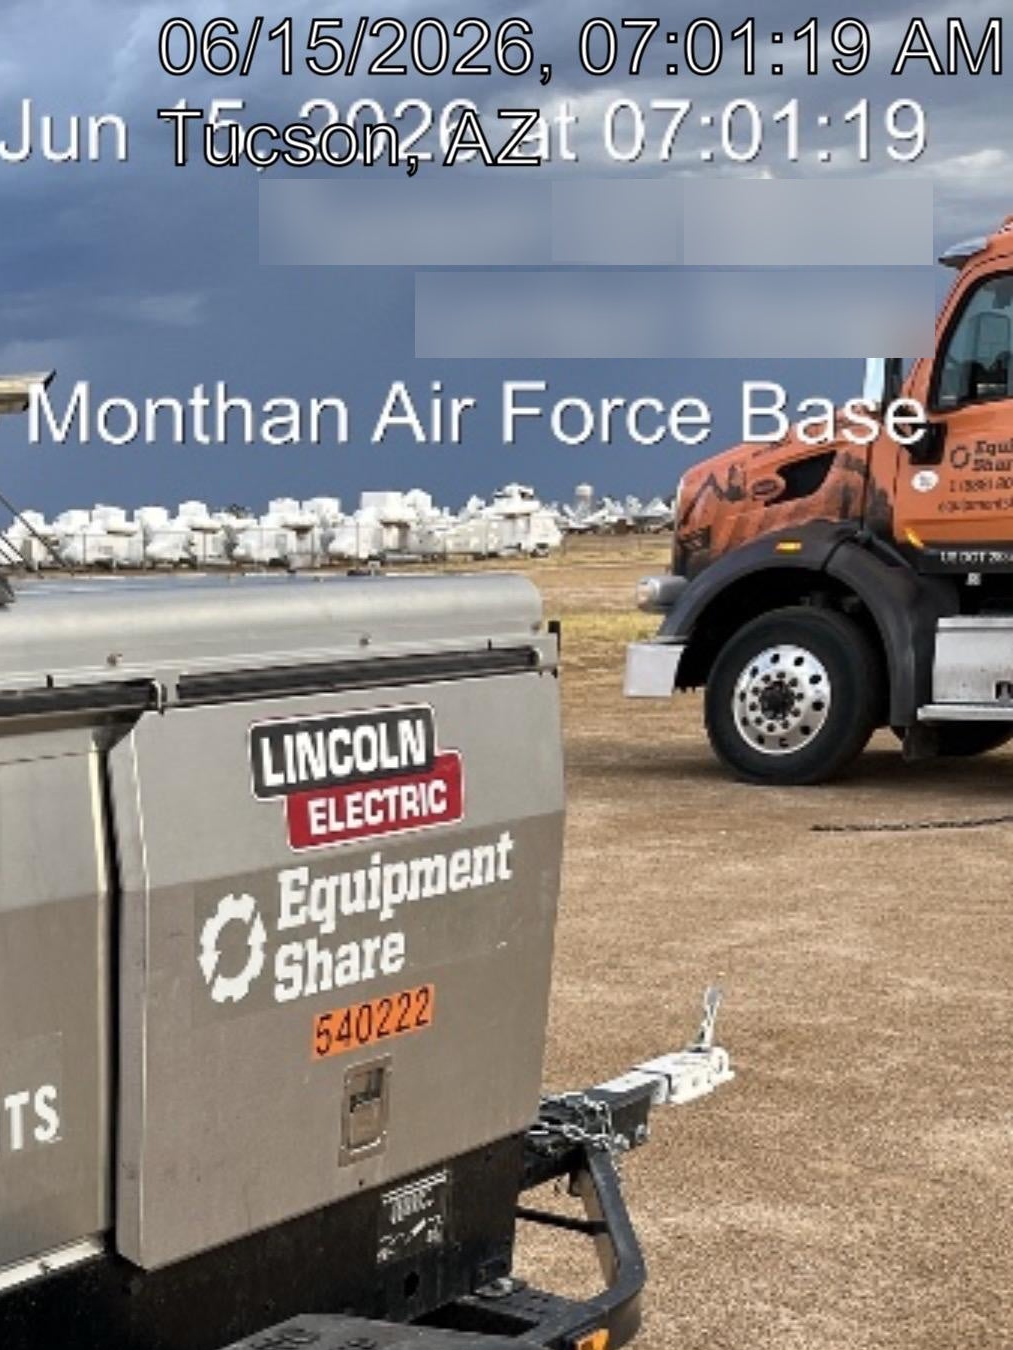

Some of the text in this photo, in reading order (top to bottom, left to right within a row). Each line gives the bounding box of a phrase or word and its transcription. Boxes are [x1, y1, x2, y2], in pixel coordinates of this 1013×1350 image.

[261, 719, 426, 787] LINCOLN
[307, 778, 448, 836] ELECTRIC
[277, 831, 515, 933] Equipment
[274, 931, 406, 1003] Share
[316, 987, 431, 1056] 540222
